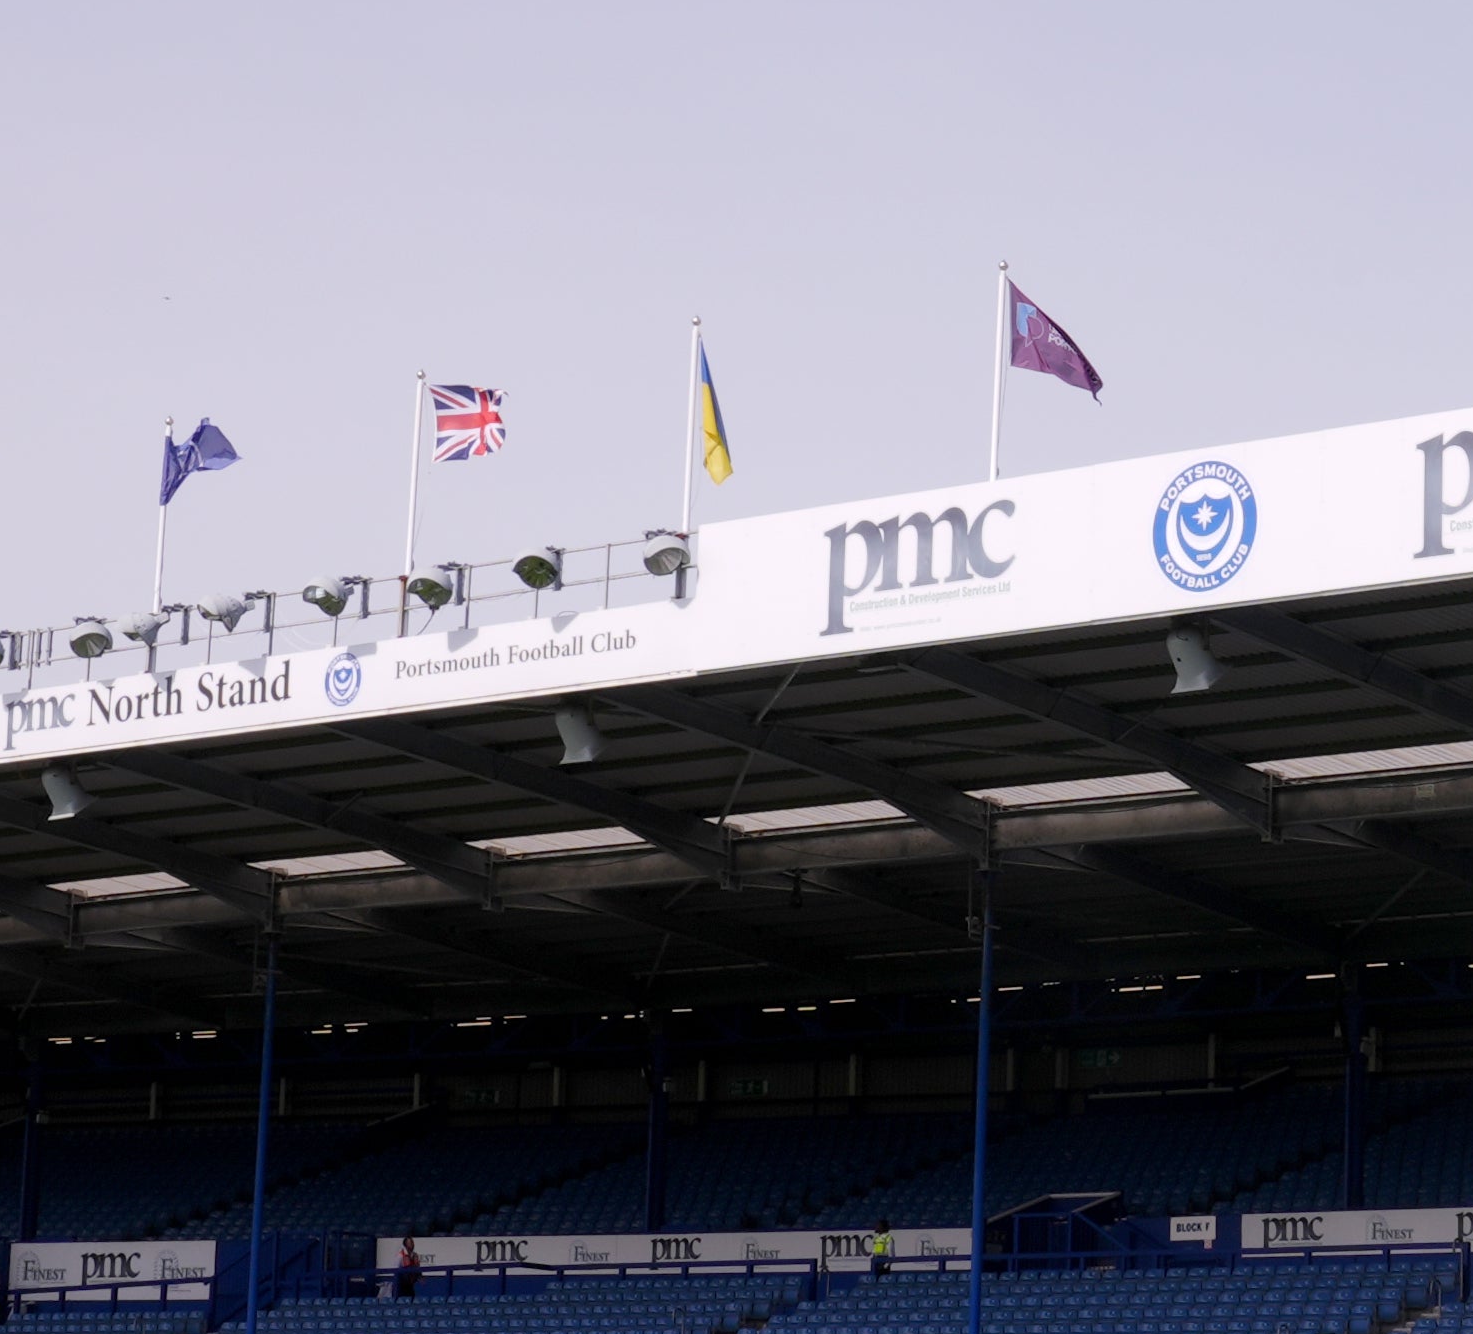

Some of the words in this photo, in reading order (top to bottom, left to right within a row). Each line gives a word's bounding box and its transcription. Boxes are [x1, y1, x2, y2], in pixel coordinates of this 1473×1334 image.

[1160, 464, 1251, 512] PORTSMOUTH
[819, 499, 1015, 637] pmc
[1160, 554, 1219, 588] FOOTBALL
[1220, 544, 1248, 579] CLUB
[849, 598, 899, 613] Construction
[909, 588, 960, 605] Development
[962, 584, 997, 598] Services
[998, 581, 1011, 593] Ltd
[395, 653, 500, 680] Portsmouth
[508, 635, 583, 665] Football
[591, 629, 636, 655] Club
[4, 693, 76, 751] pmc
[86, 675, 183, 726] North
[196, 659, 291, 712] Stand
[1176, 1223, 1203, 1233] BLOCK
[1205, 1222, 1210, 1232] F
[1262, 1216, 1323, 1248] pmc
[1371, 1221, 1414, 1240] FINEST
[23, 1259, 67, 1281] FINEST
[82, 1252, 141, 1286] pmc
[161, 1258, 207, 1279] FINEST
[476, 1238, 528, 1270] pmc
[574, 1244, 610, 1262] FINEST
[650, 1236, 702, 1269] pmc
[745, 1243, 781, 1260] FINEST
[820, 1233, 874, 1267] pmc
[920, 1239, 957, 1257] FINEST
